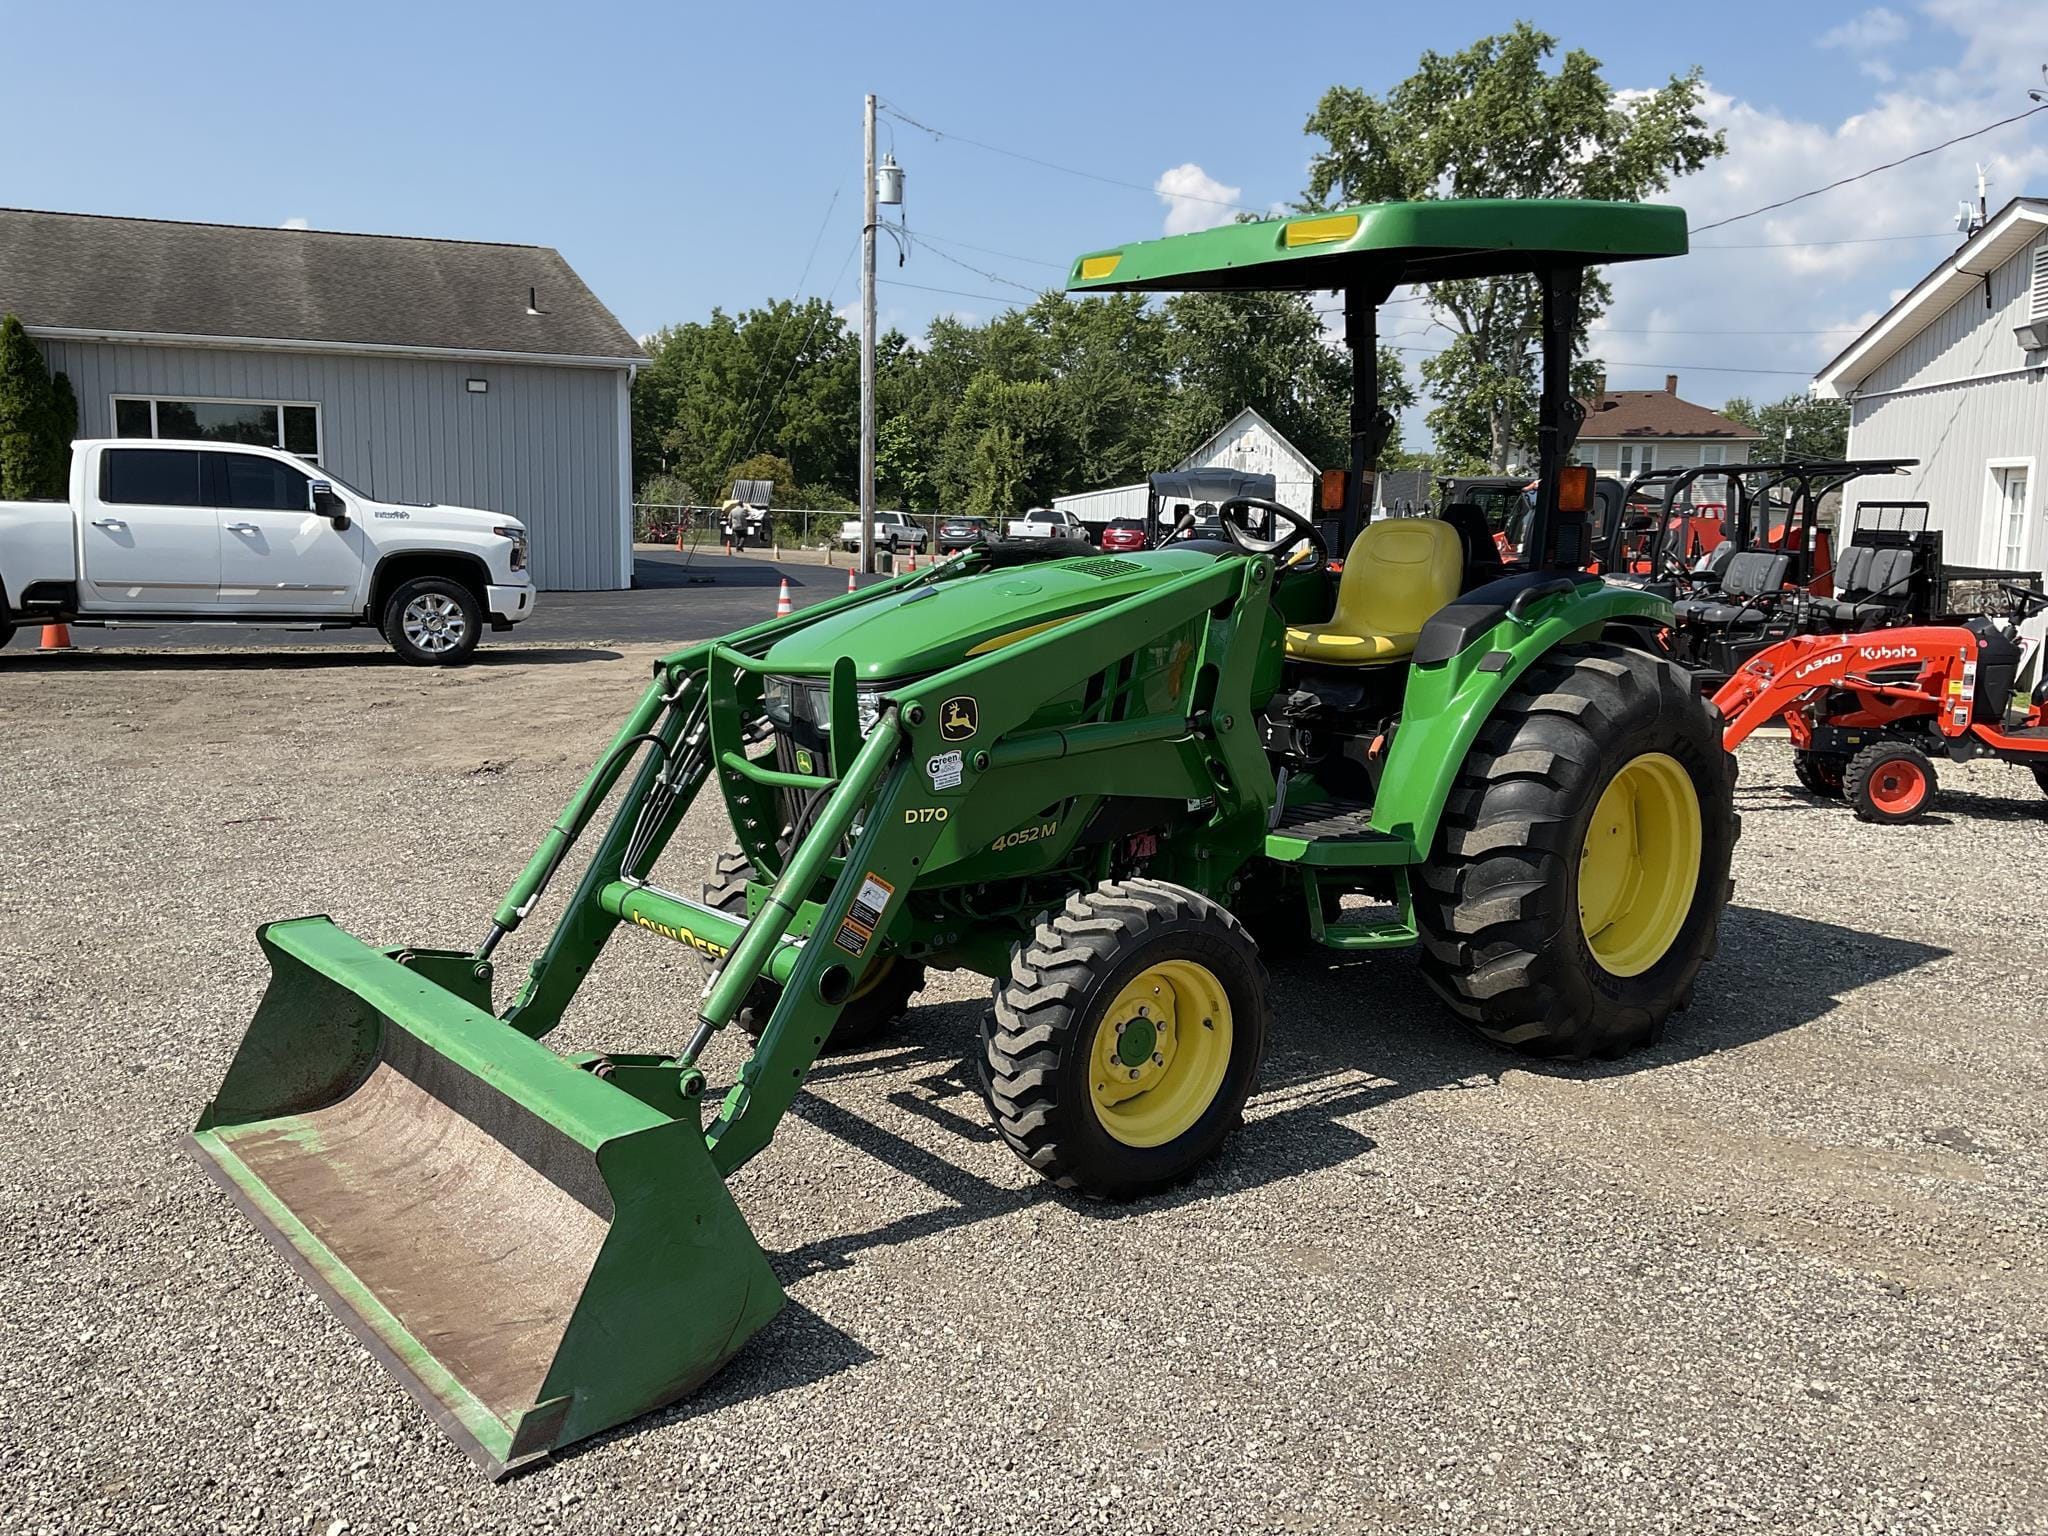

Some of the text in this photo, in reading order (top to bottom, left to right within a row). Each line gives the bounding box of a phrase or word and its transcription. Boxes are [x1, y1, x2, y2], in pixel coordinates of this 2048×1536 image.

[1860, 645, 1917, 660] Kubota
[1796, 653, 1843, 679] LA340
[929, 754, 958, 774] Green
[905, 807, 948, 824] D170
[991, 821, 1057, 852] 4052M
